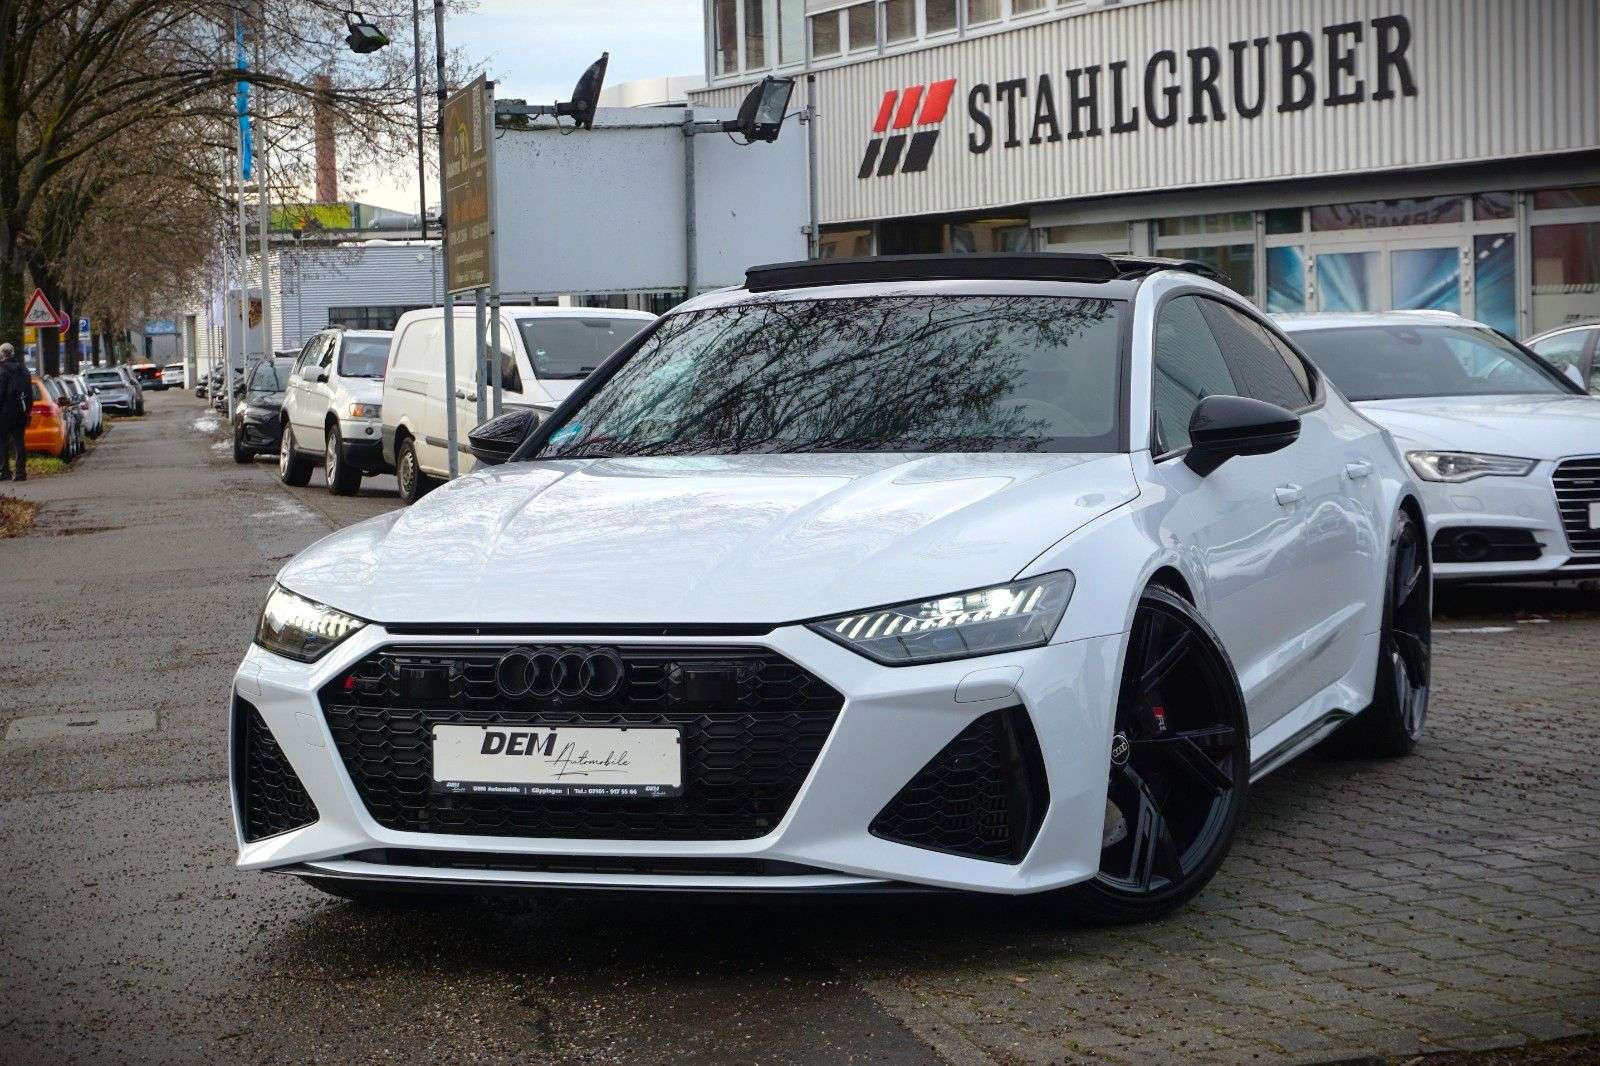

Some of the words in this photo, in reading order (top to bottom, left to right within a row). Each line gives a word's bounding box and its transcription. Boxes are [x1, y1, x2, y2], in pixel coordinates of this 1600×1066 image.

[968, 14, 1418, 154] STAHLGRUBER
[481, 731, 558, 756] DEM
[545, 742, 631, 780] Automobile
